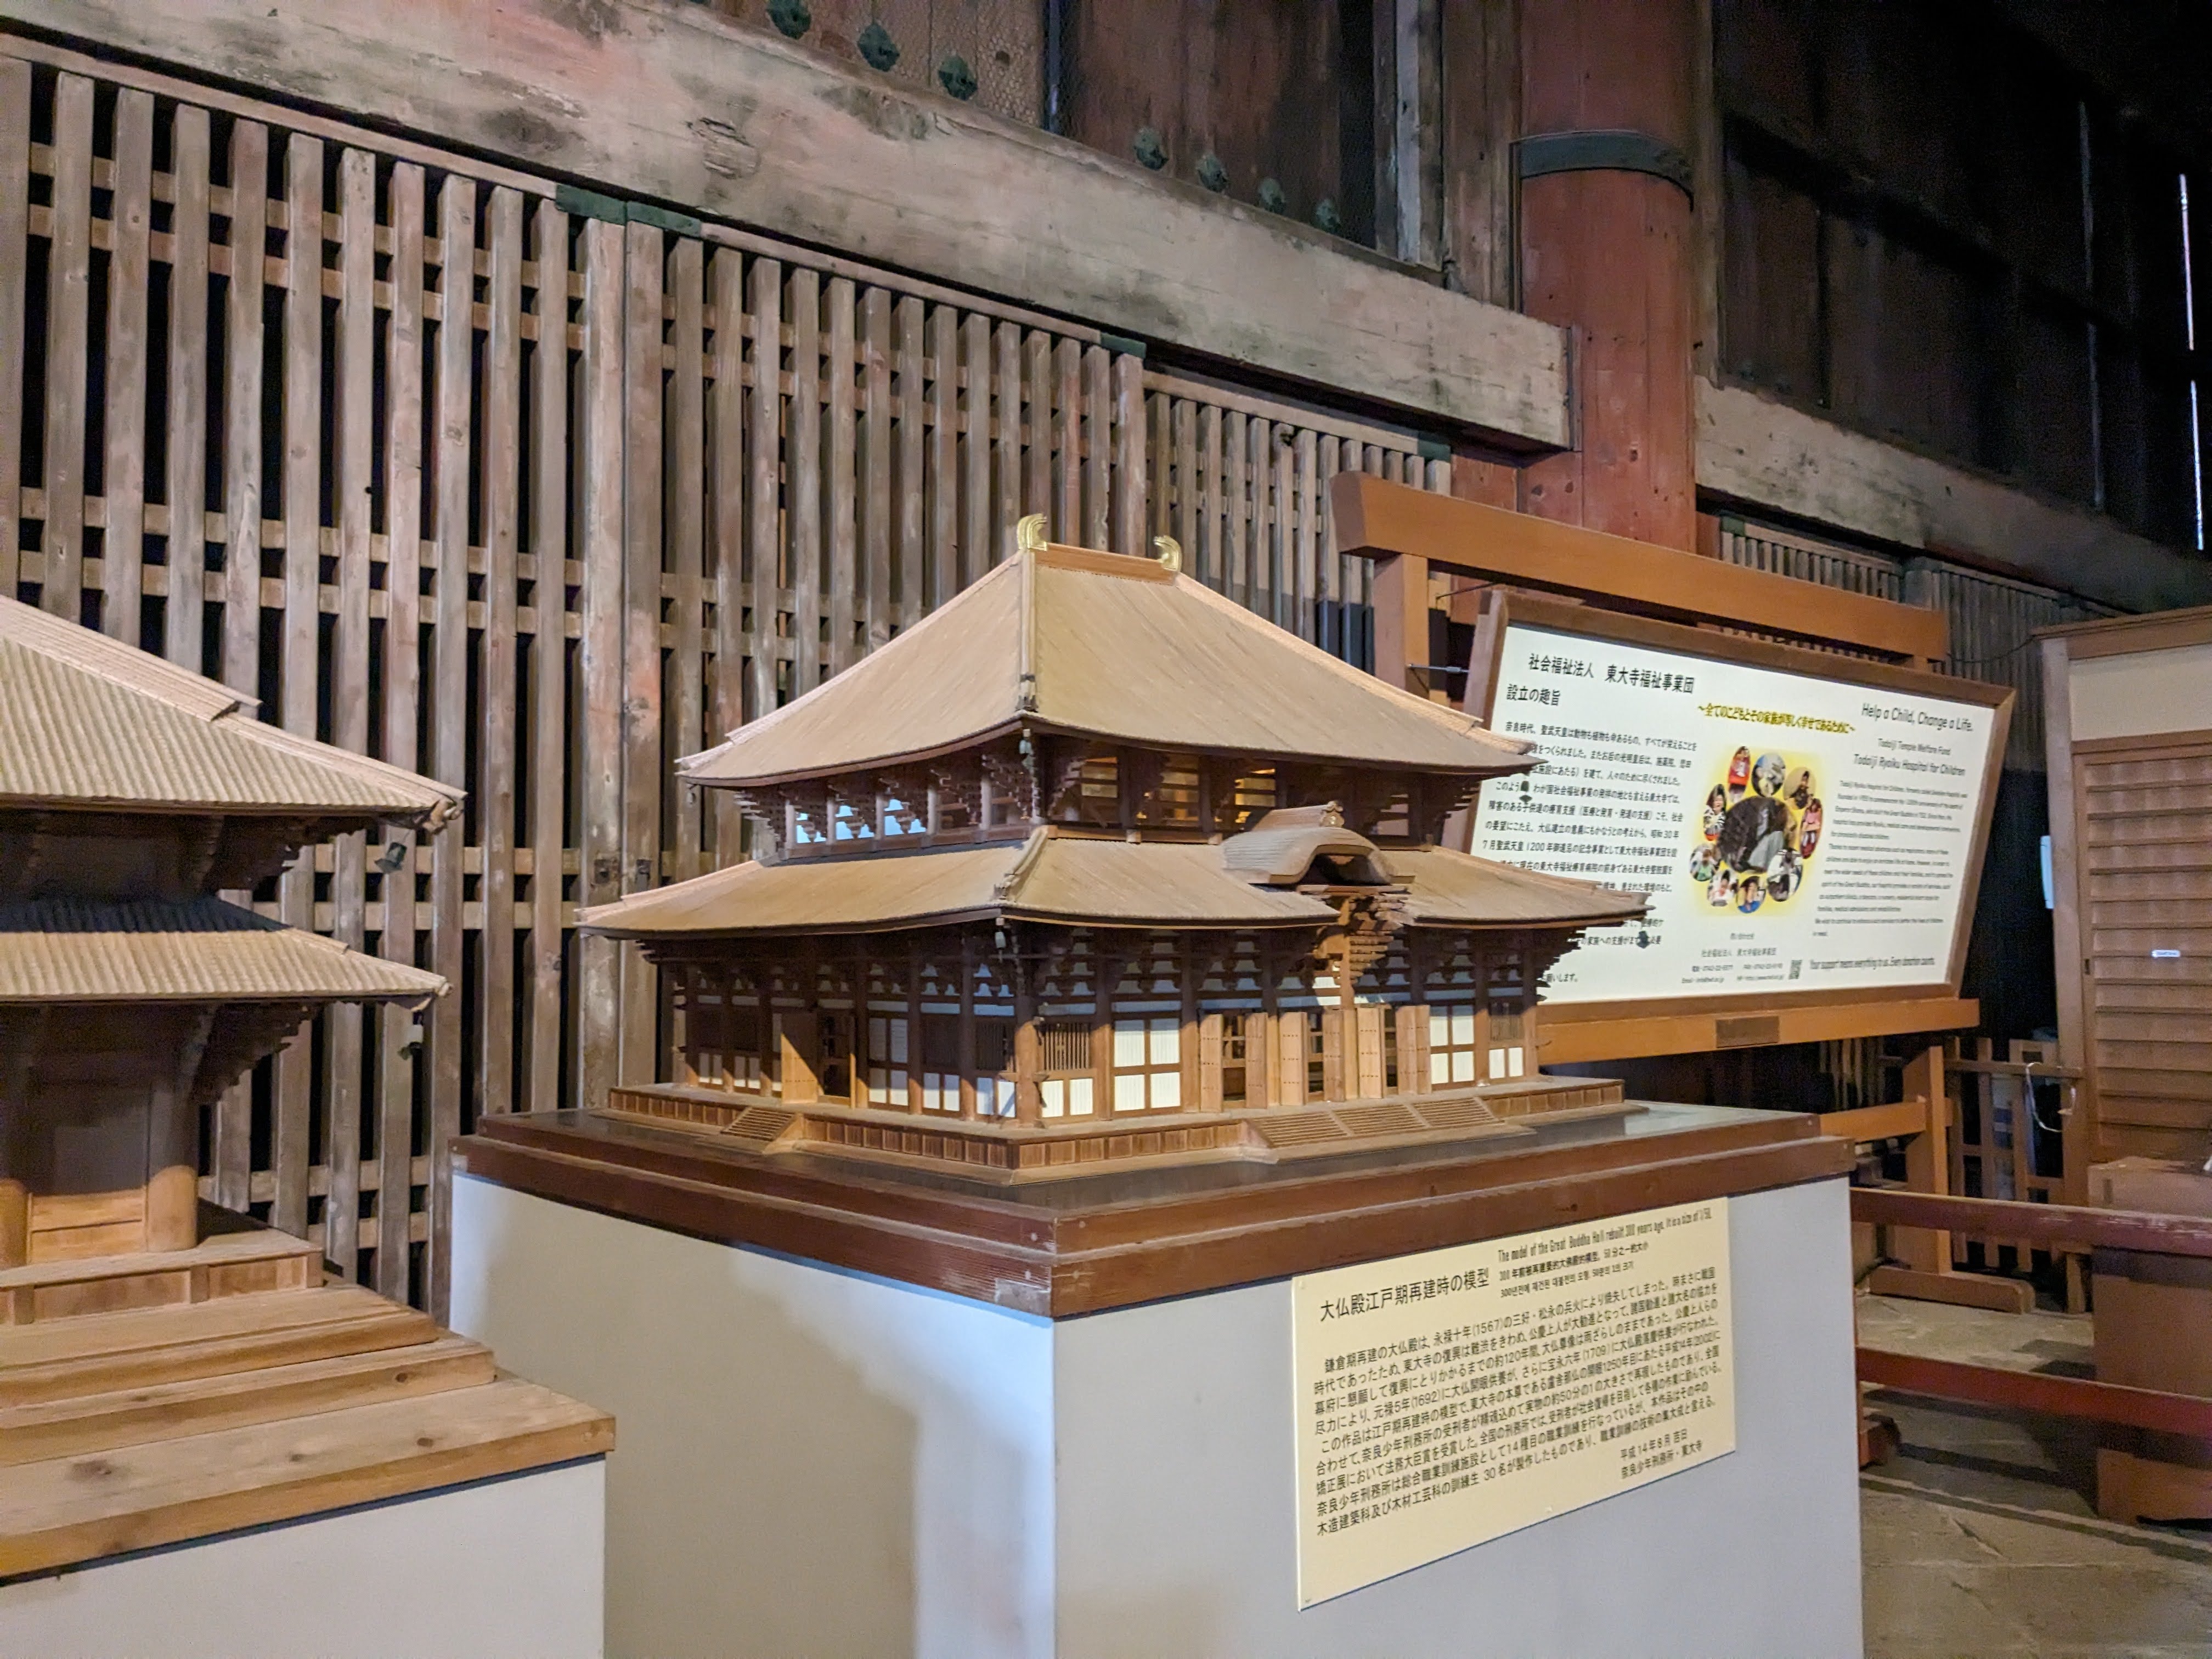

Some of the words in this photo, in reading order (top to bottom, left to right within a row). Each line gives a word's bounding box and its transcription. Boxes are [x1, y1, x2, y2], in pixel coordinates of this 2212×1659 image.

[1528, 653, 1594, 678] 社会福祉法人
[1605, 663, 1695, 694] 東大寺福祉事業団
[1506, 684, 1560, 706] 設立の趣旨
[1862, 703, 1881, 721] Help
[1884, 710, 1889, 719] a
[1892, 707, 1915, 724] Child,
[1918, 712, 1947, 730] Change
[1949, 720, 1954, 729] a
[1498, 1248, 1509, 1262] The
[1549, 1237, 1566, 1252] Great
[1320, 1266, 1489, 1323] 大仏殿江戸期再建時の模型
